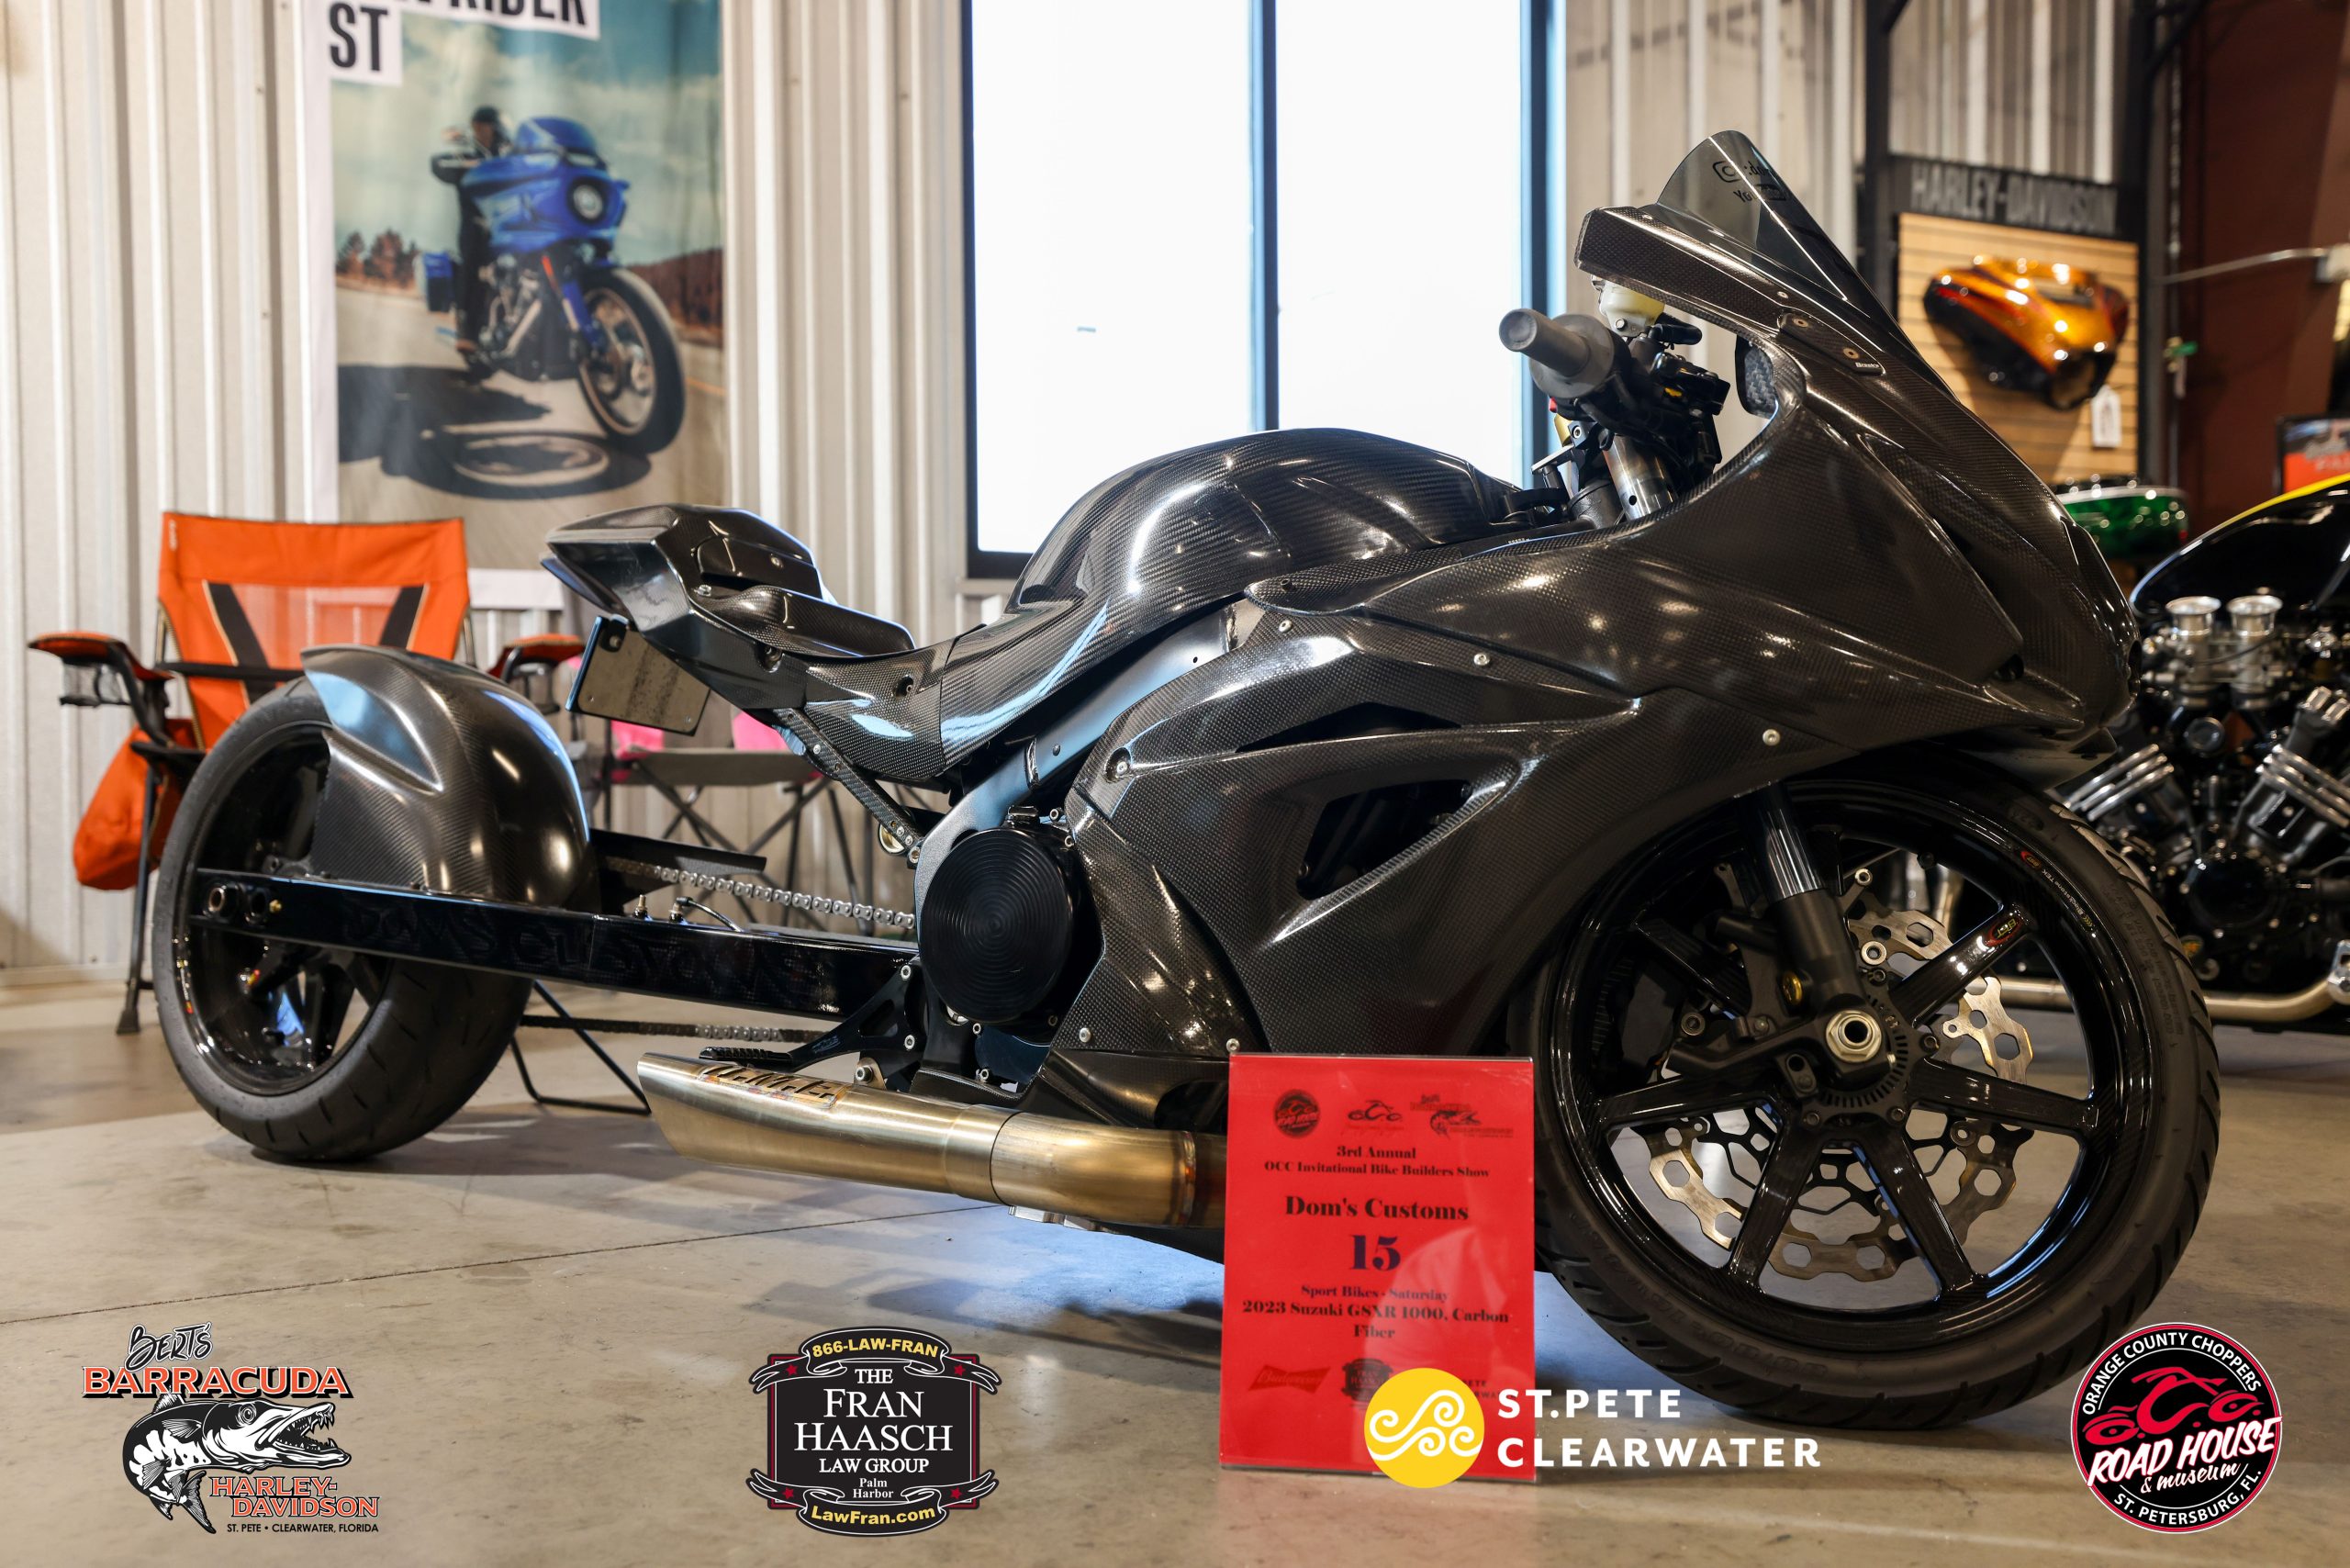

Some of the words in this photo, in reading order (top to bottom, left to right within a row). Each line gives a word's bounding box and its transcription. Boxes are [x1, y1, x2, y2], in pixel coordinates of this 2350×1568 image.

[329, 2, 388, 72] ST
[1337, 1146, 1361, 1158] 3rd
[1366, 1146, 1416, 1159] Annual
[1264, 1160, 1292, 1171] OCC
[1296, 1161, 1367, 1174] Invitational
[1371, 1164, 1399, 1176] Bike
[1402, 1165, 1454, 1177] Builders
[1456, 1167, 1489, 1178] Show
[1285, 1195, 1358, 1217] Dom's
[1365, 1197, 1470, 1221] Customs
[1349, 1234, 1402, 1271] 15
[1301, 1284, 1337, 1302] Sport
[1342, 1285, 1379, 1299] Bikes
[1389, 1287, 1449, 1305] Saturday
[1242, 1300, 1287, 1315] 2023
[1290, 1302, 1343, 1318] Suzuki
[1347, 1304, 1396, 1319] GSXR
[1452, 1309, 1509, 1324] Carbon
[1354, 1325, 1395, 1338] Fiber
